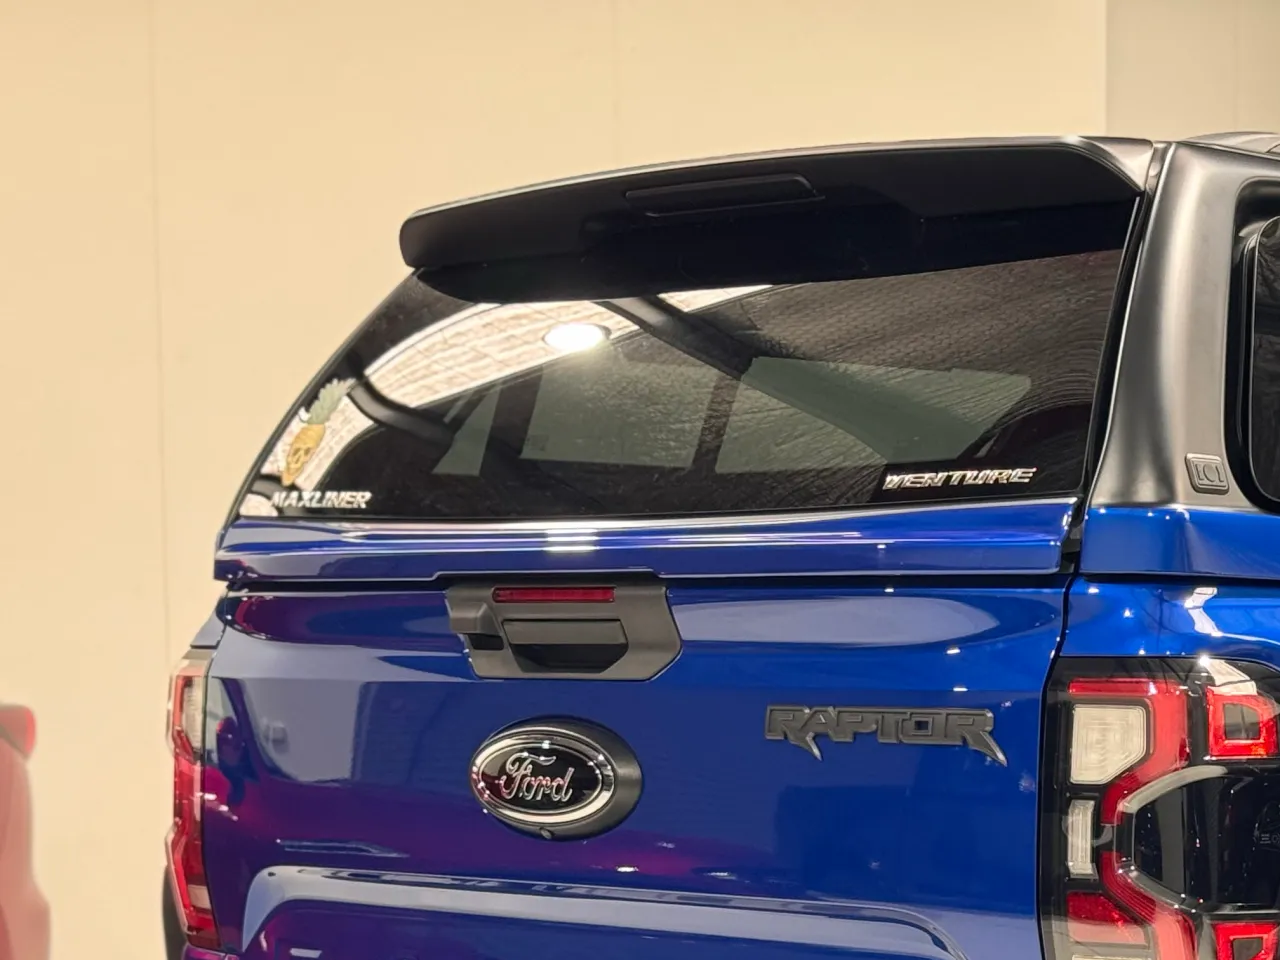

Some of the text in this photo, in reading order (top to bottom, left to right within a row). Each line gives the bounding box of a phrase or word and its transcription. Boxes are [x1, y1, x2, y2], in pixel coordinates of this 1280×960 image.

[882, 467, 1037, 491] VENTURE
[271, 490, 372, 509] MAXLINER
[764, 705, 1008, 767] RAPTOR
[499, 751, 576, 802] Ford
